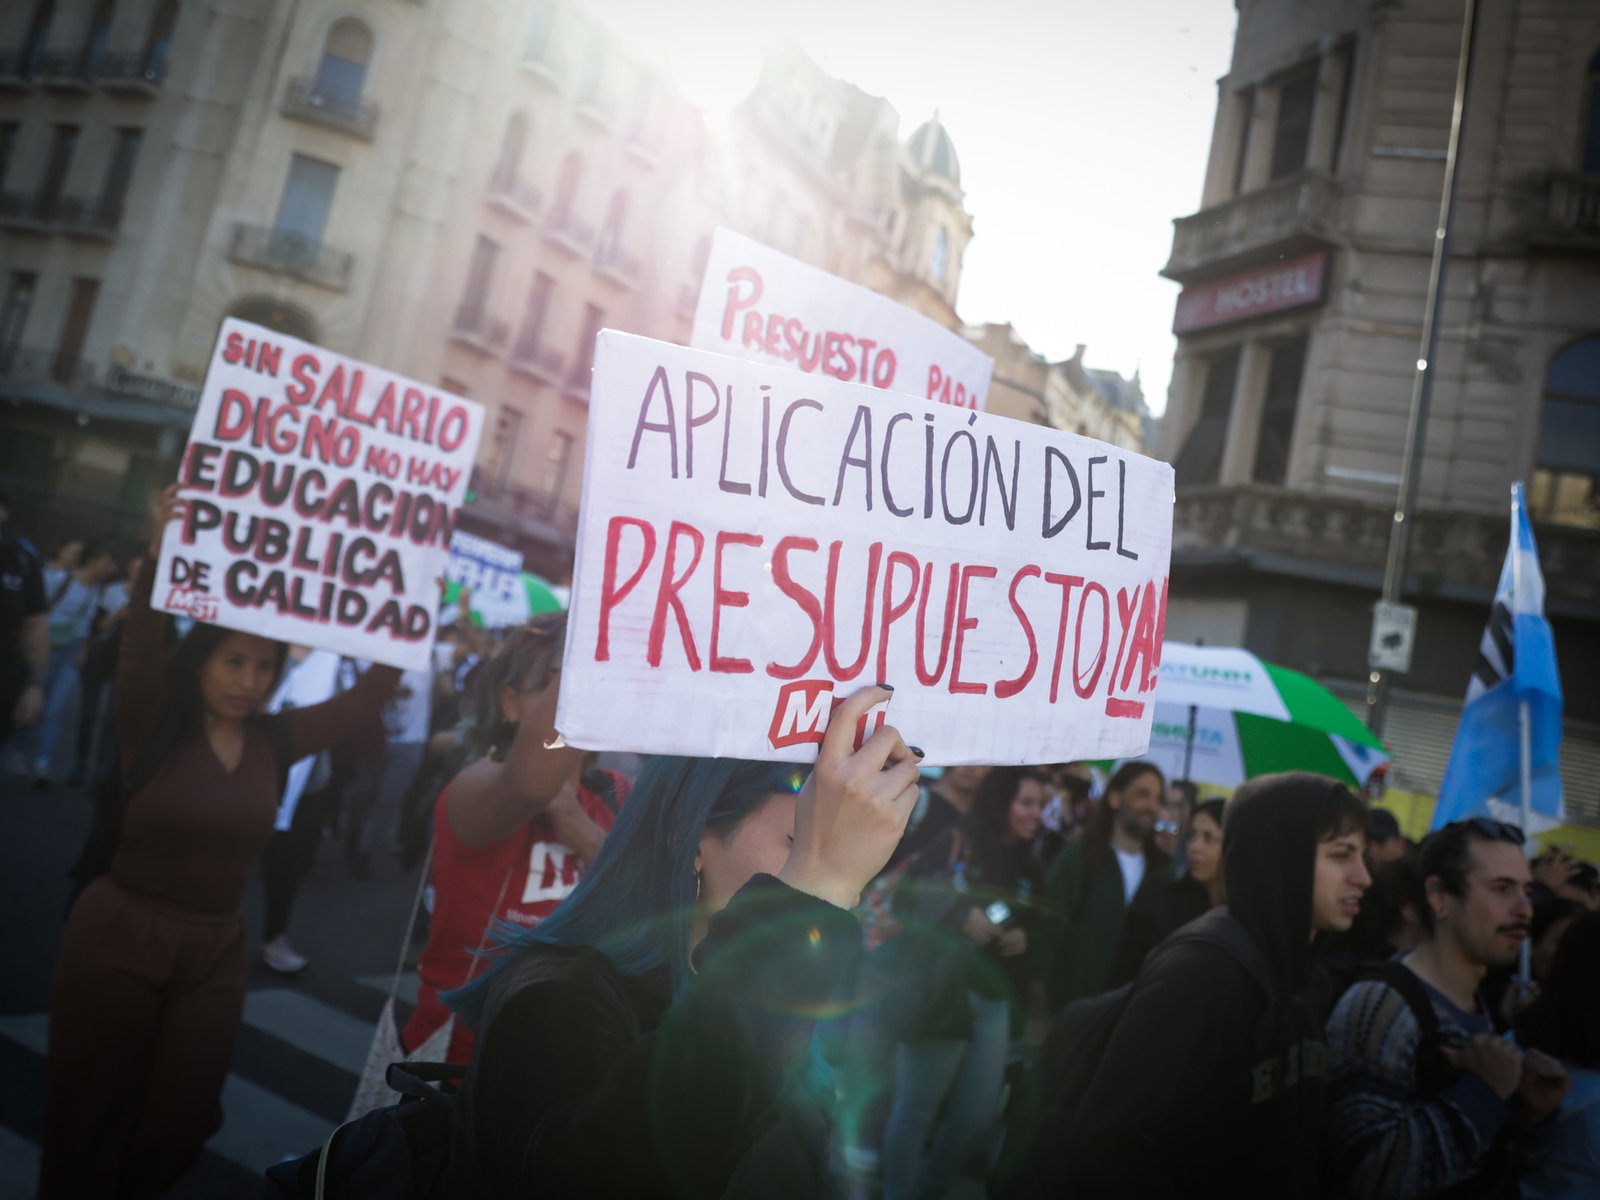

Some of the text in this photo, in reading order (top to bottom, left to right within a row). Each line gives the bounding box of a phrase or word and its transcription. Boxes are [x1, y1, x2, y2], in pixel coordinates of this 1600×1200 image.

[720, 266, 897, 390] PRESUESTO
[1215, 266, 1308, 314] HOSTEL
[214, 388, 461, 494] DIGNO NO HAY
[223, 332, 469, 452] SIN SALARIO
[181, 500, 405, 594] PUBLICA
[183, 442, 461, 551] EDUCACION
[1042, 446, 1139, 561] DEL
[170, 556, 431, 642] DE CALIDAD
[777, 689, 889, 746] MT
